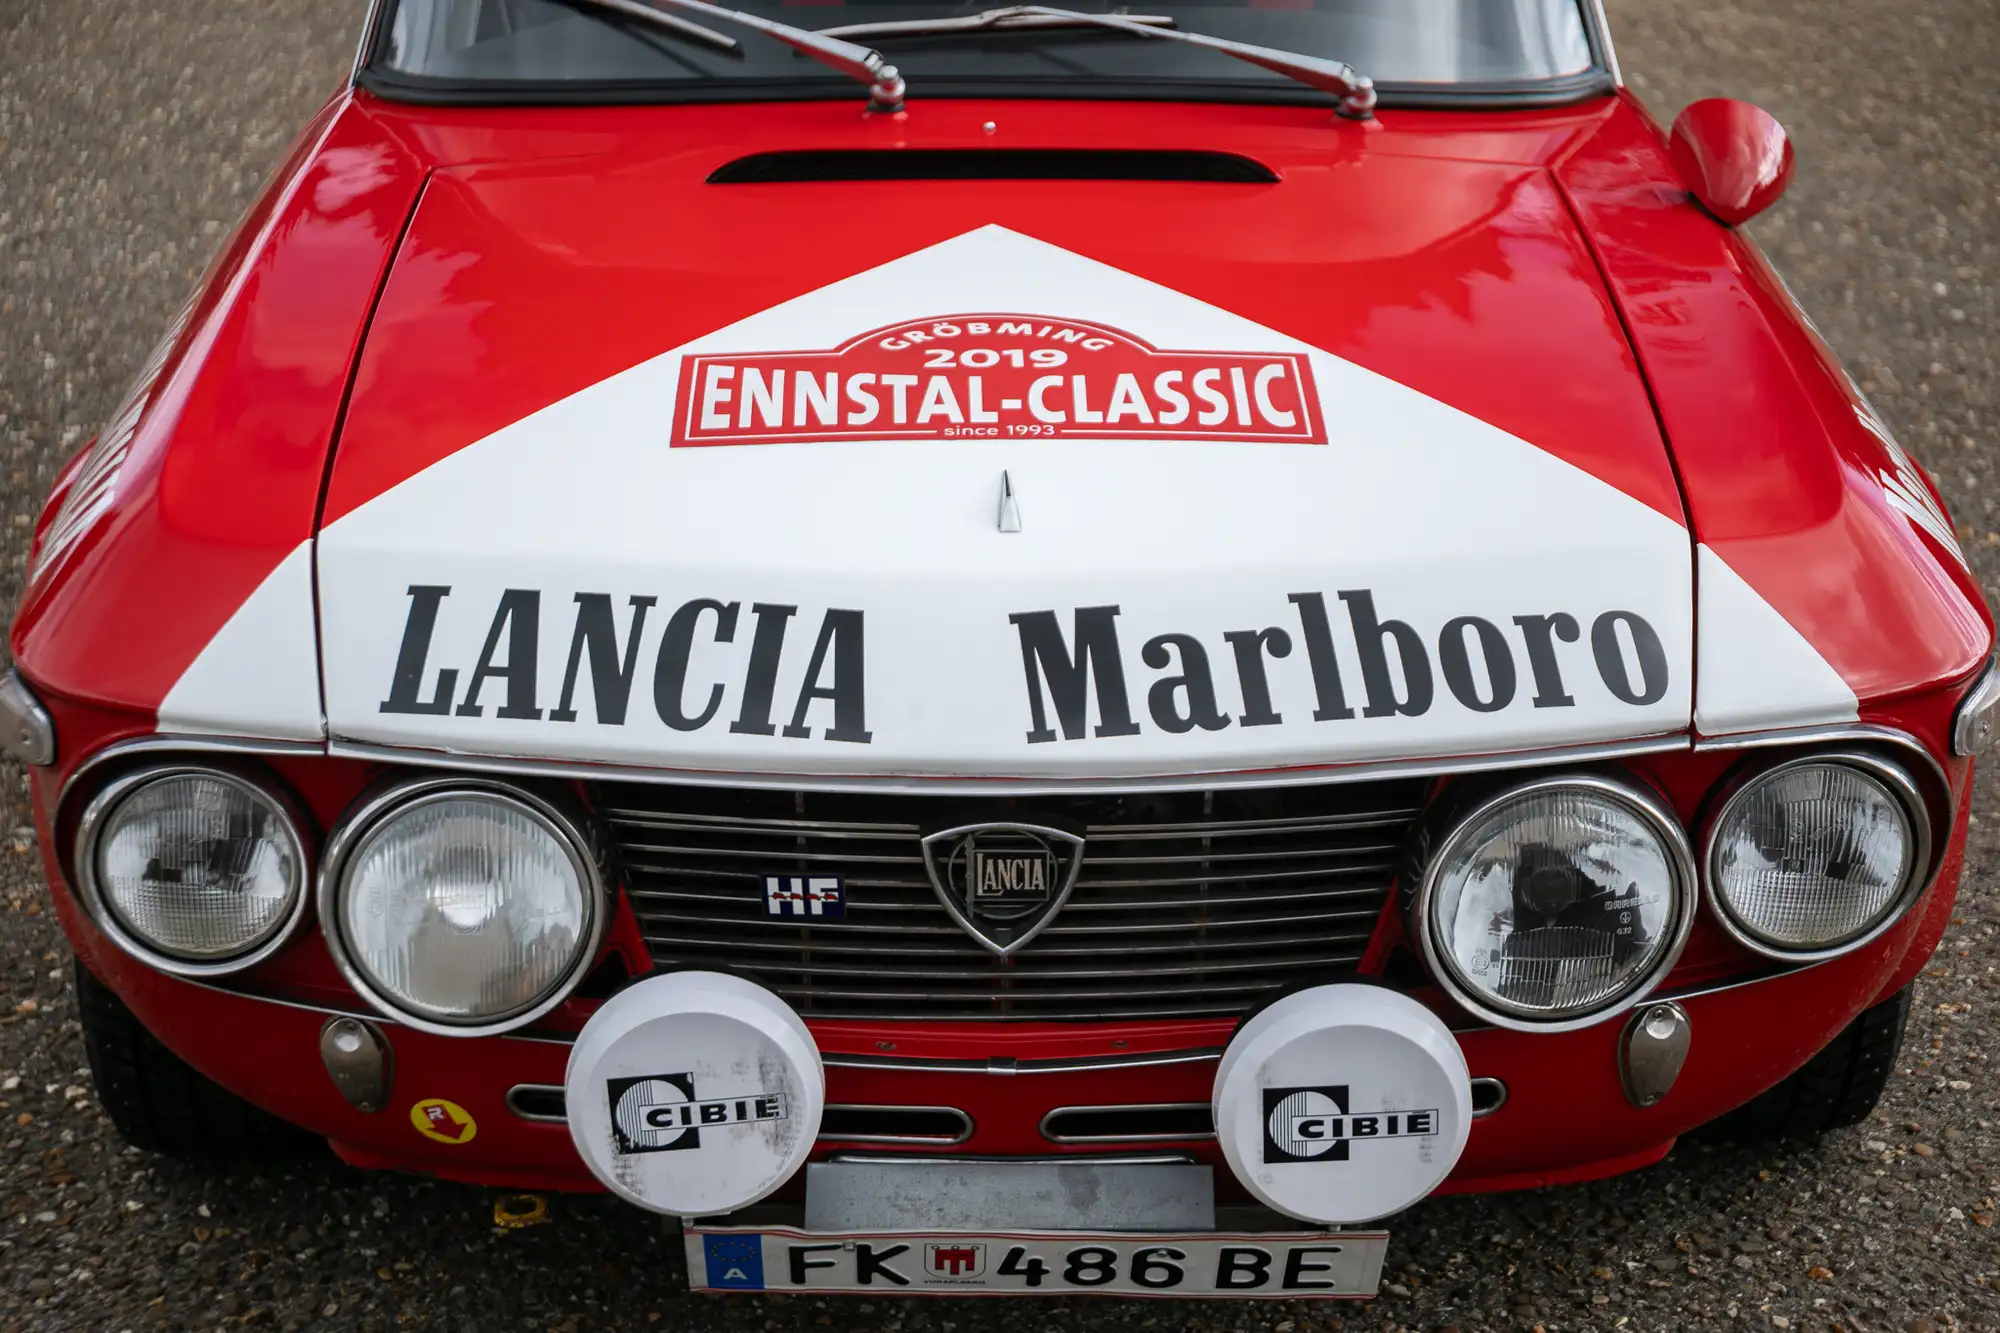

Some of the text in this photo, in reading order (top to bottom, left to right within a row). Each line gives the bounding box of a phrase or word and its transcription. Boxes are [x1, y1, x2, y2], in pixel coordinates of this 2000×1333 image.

[879, 321, 1115, 351] GRÖBMING
[923, 348, 1068, 368] 2019
[698, 362, 1297, 429] ENNSTAL-CLASSIC
[943, 424, 1055, 436] since 1993
[378, 584, 873, 744] LANCIA
[1008, 588, 1669, 744] Marlboro
[977, 853, 1046, 896] LANCIA
[766, 877, 839, 915] HF
[428, 1107, 445, 1120] R
[724, 1268, 748, 1279] A
[789, 1243, 1343, 1289] FK 486 BE
